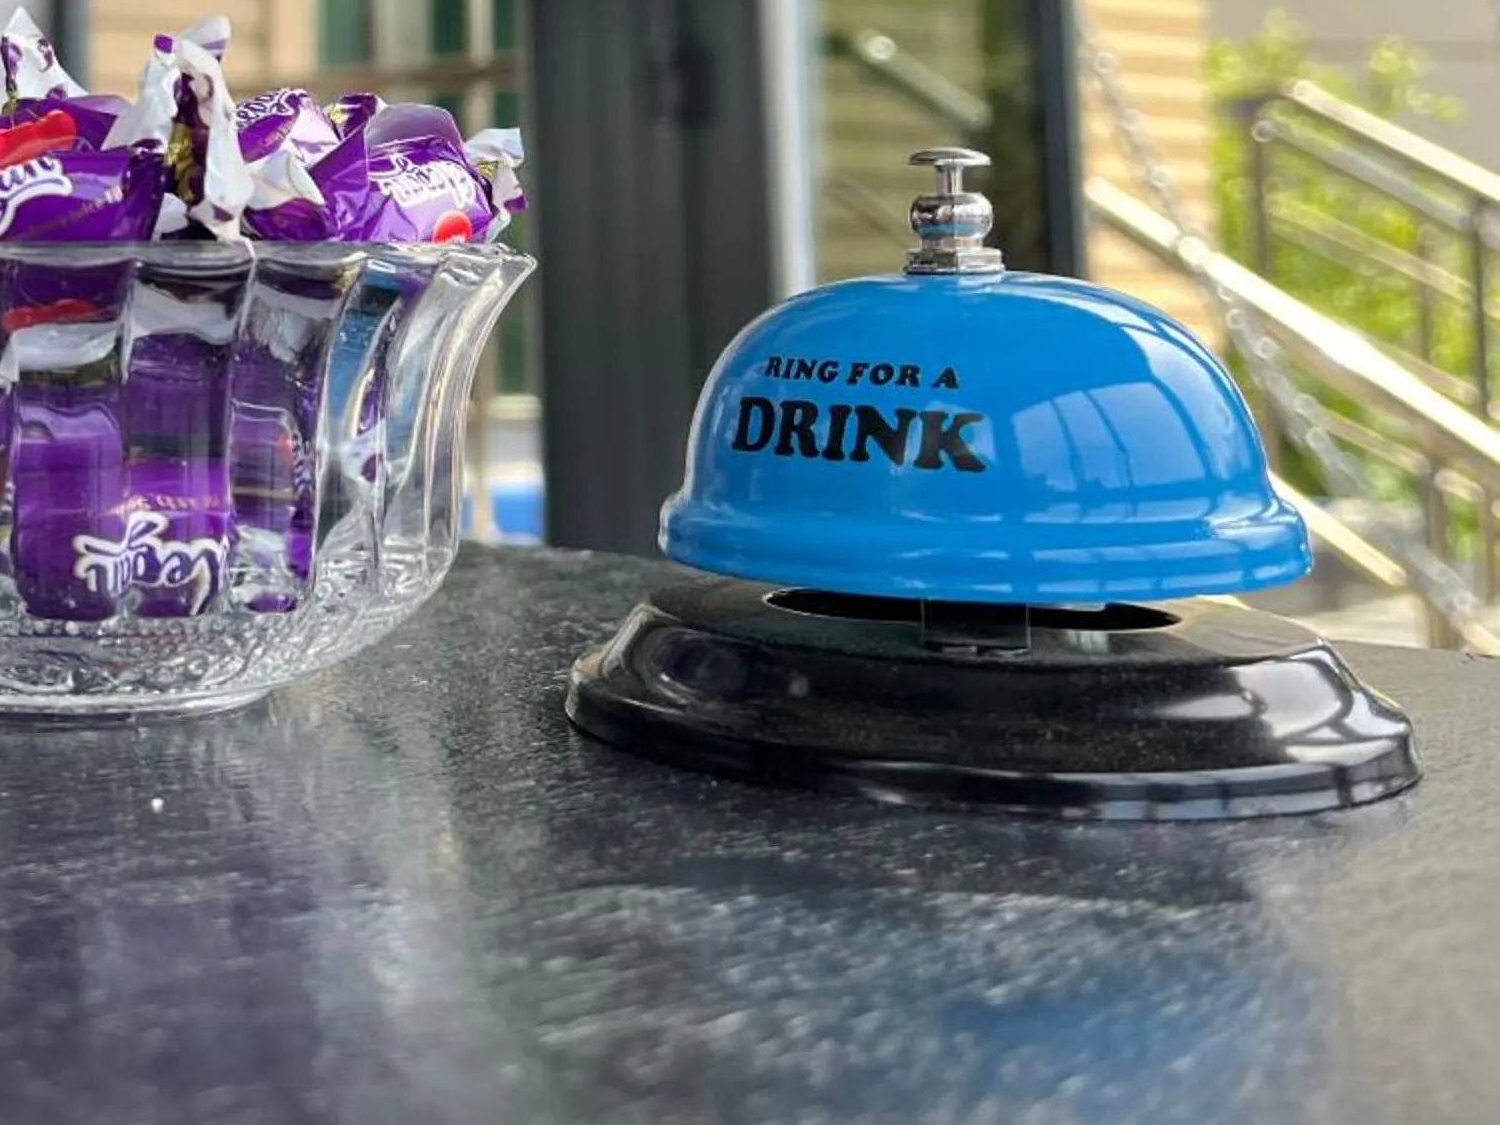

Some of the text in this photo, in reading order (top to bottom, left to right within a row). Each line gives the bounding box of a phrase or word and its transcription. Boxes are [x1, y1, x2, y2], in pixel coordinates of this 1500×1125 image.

[765, 356, 959, 389] RING FOR A
[732, 396, 986, 472] DRINK
